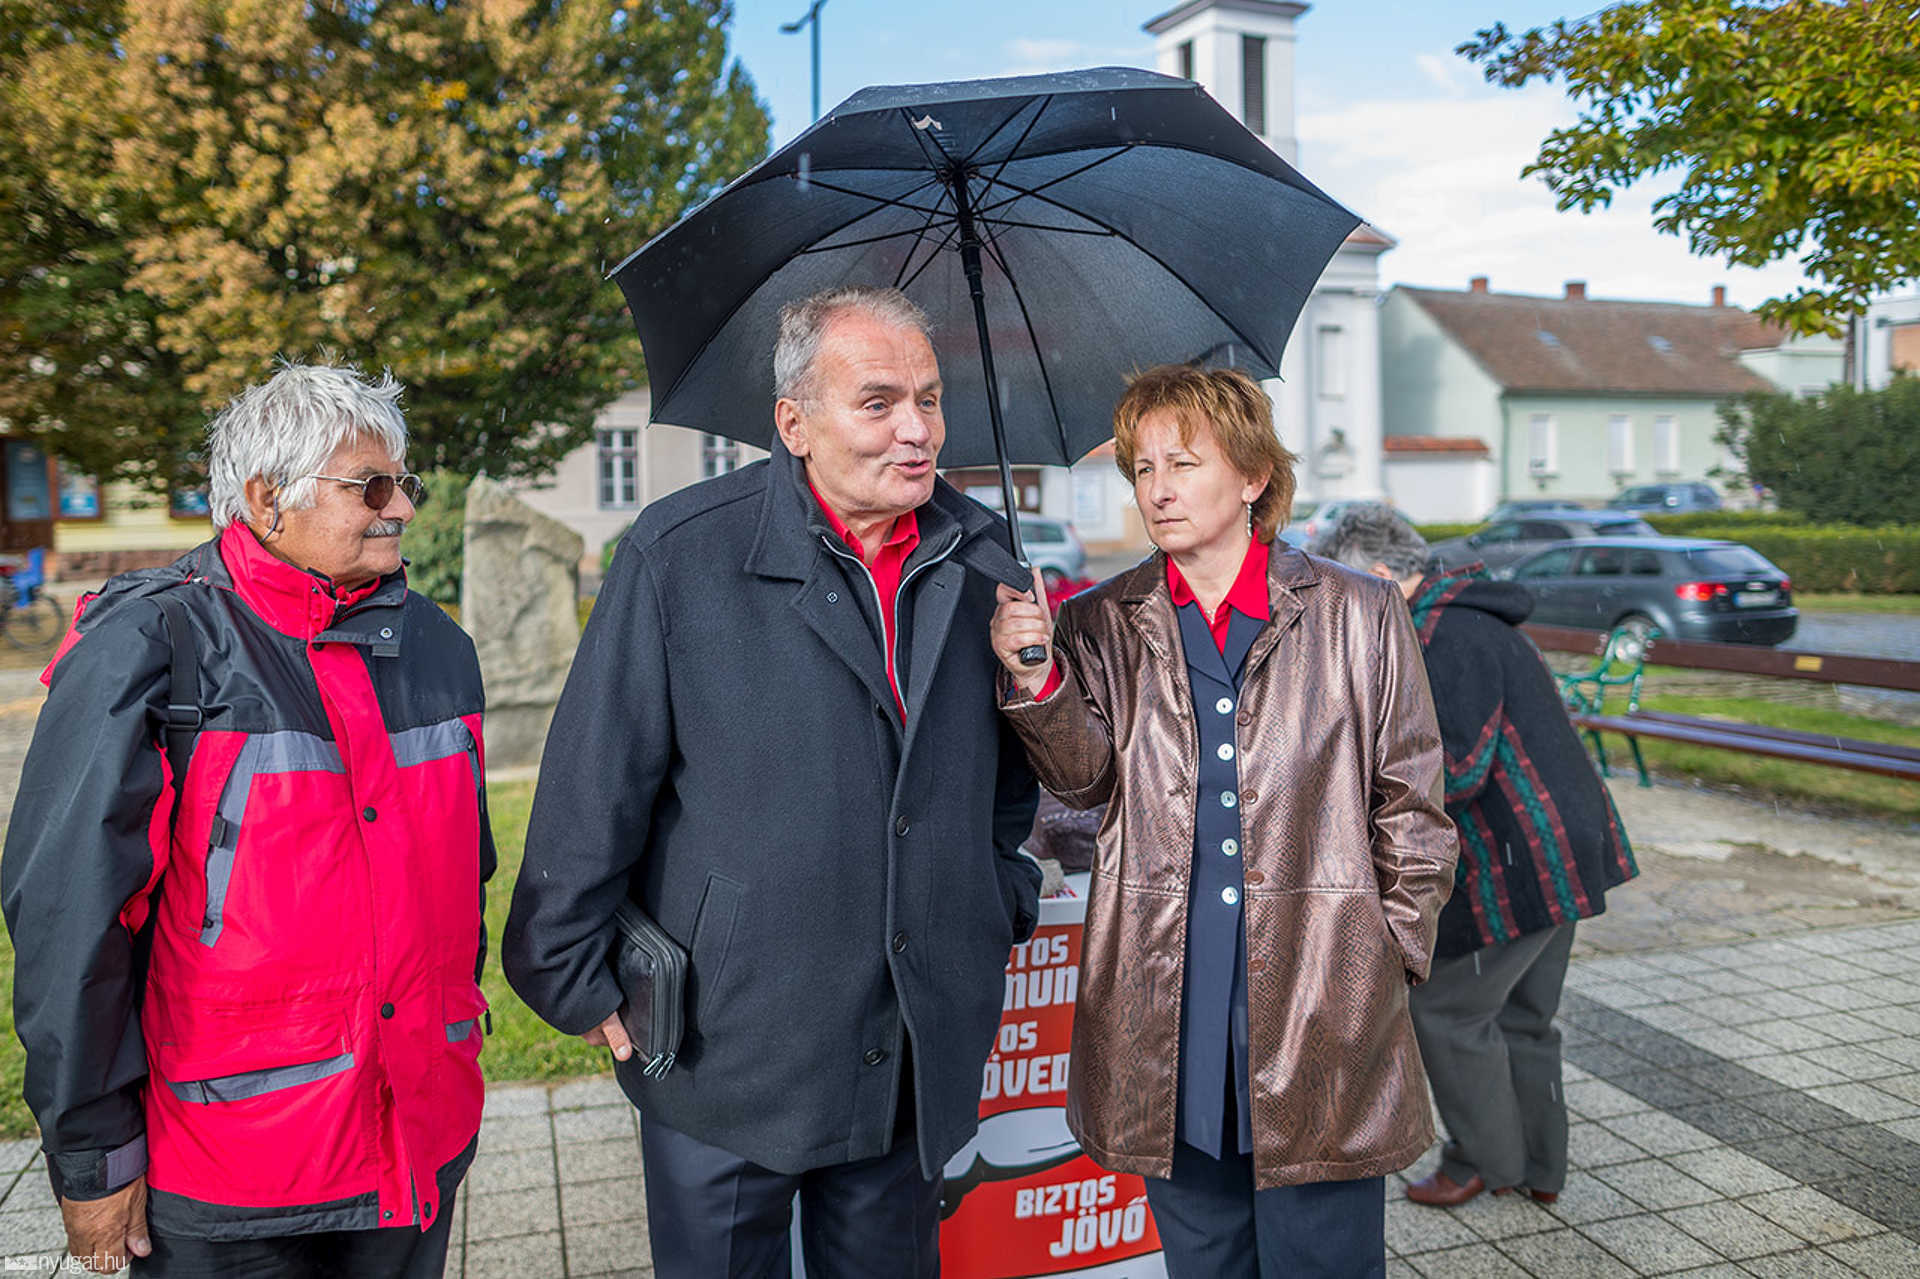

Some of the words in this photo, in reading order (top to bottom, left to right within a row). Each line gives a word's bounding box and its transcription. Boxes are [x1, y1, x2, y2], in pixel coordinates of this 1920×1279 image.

[1005, 934, 1069, 971] TOS
[990, 1020, 1038, 1053] OS
[1015, 1174, 1117, 1219] BIZTOS
[1049, 1195, 1147, 1258] JÖVŐ
